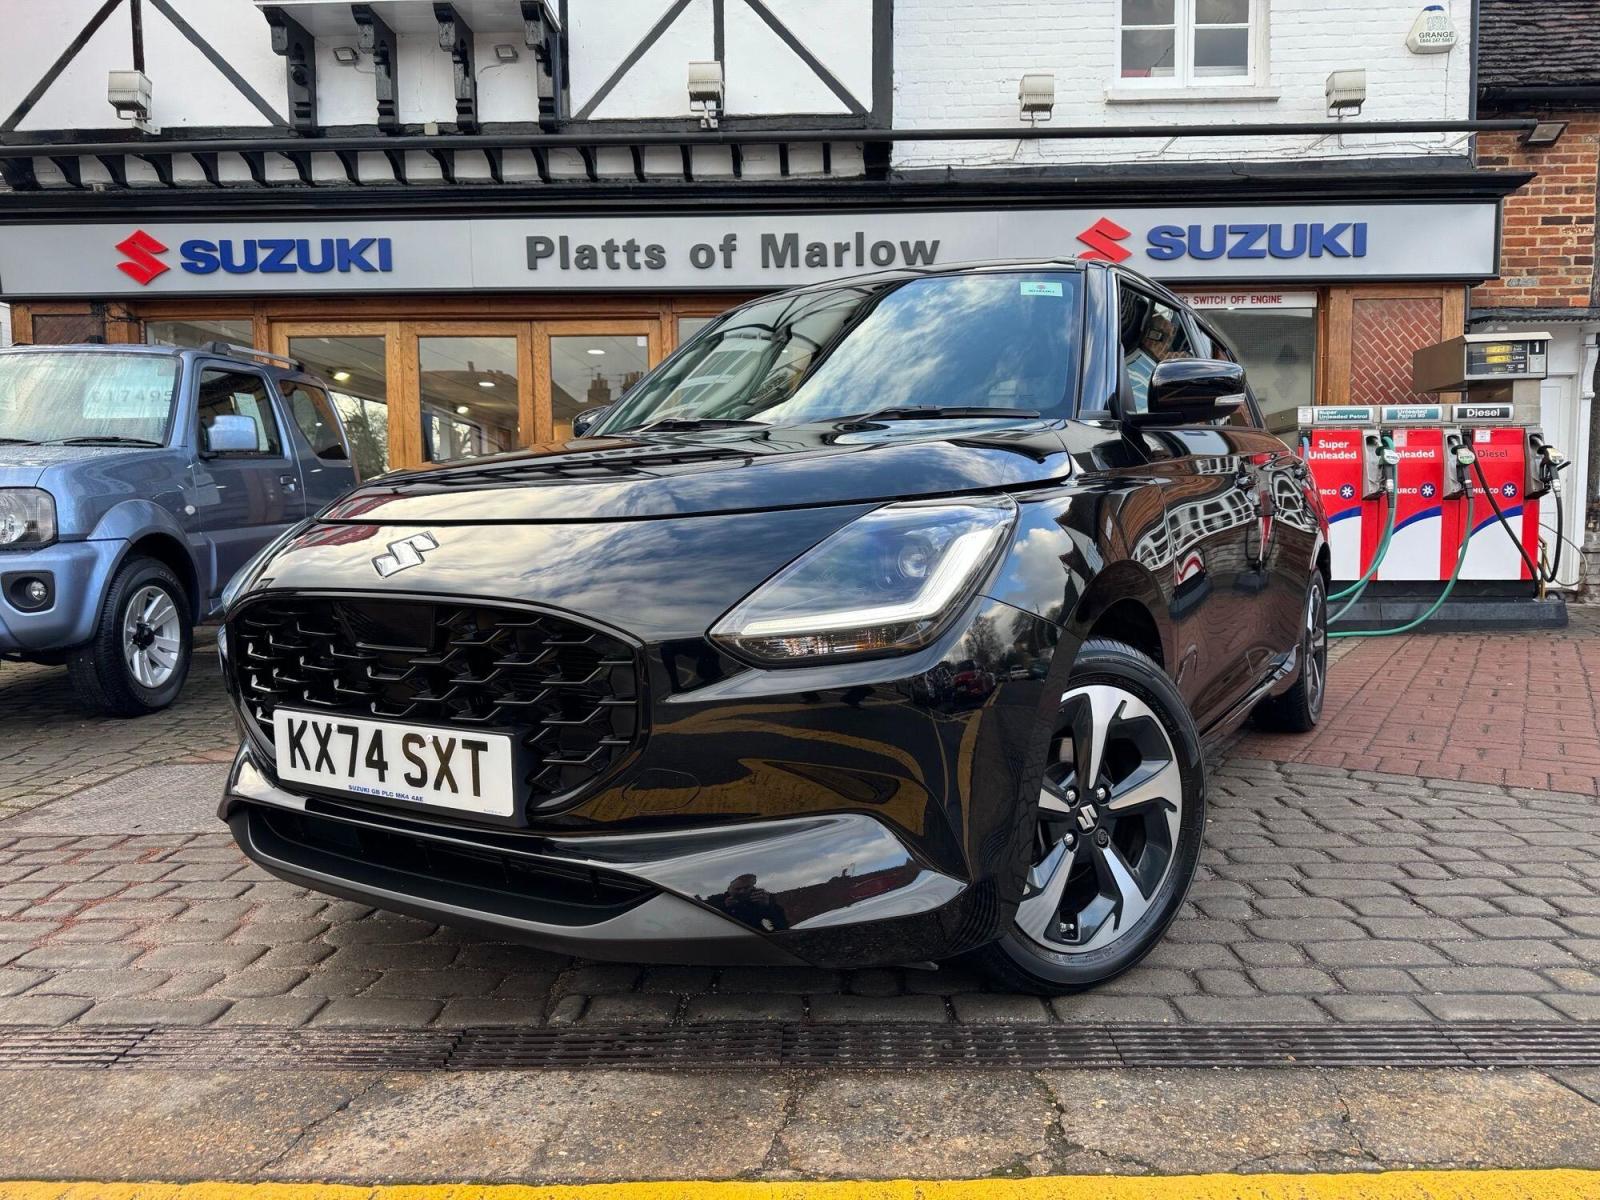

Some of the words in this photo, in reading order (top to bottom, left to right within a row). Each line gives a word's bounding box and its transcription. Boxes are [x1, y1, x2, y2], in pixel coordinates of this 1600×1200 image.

[1145, 222, 1368, 261] SUZUKI
[180, 237, 393, 275] SUZUKI
[525, 234, 667, 271] Platts
[688, 232, 738, 269] of
[760, 231, 941, 269] Marlow
[1193, 295, 1227, 305] SWITCH
[1230, 295, 1247, 305] OFF
[1250, 295, 1283, 304] ENGINE
[1534, 340, 1540, 353] 1
[1466, 408, 1500, 417] Diesel
[1318, 439, 1350, 450] Super
[1308, 451, 1357, 460] Unleaded
[1395, 449, 1435, 458] nleaded
[1477, 449, 1508, 458] Diesel
[287, 718, 389, 783] KX74
[401, 732, 489, 797] SXT
[348, 784, 370, 793] SUZUKI
[381, 790, 394, 798] PLC
[395, 792, 410, 800] MK4
